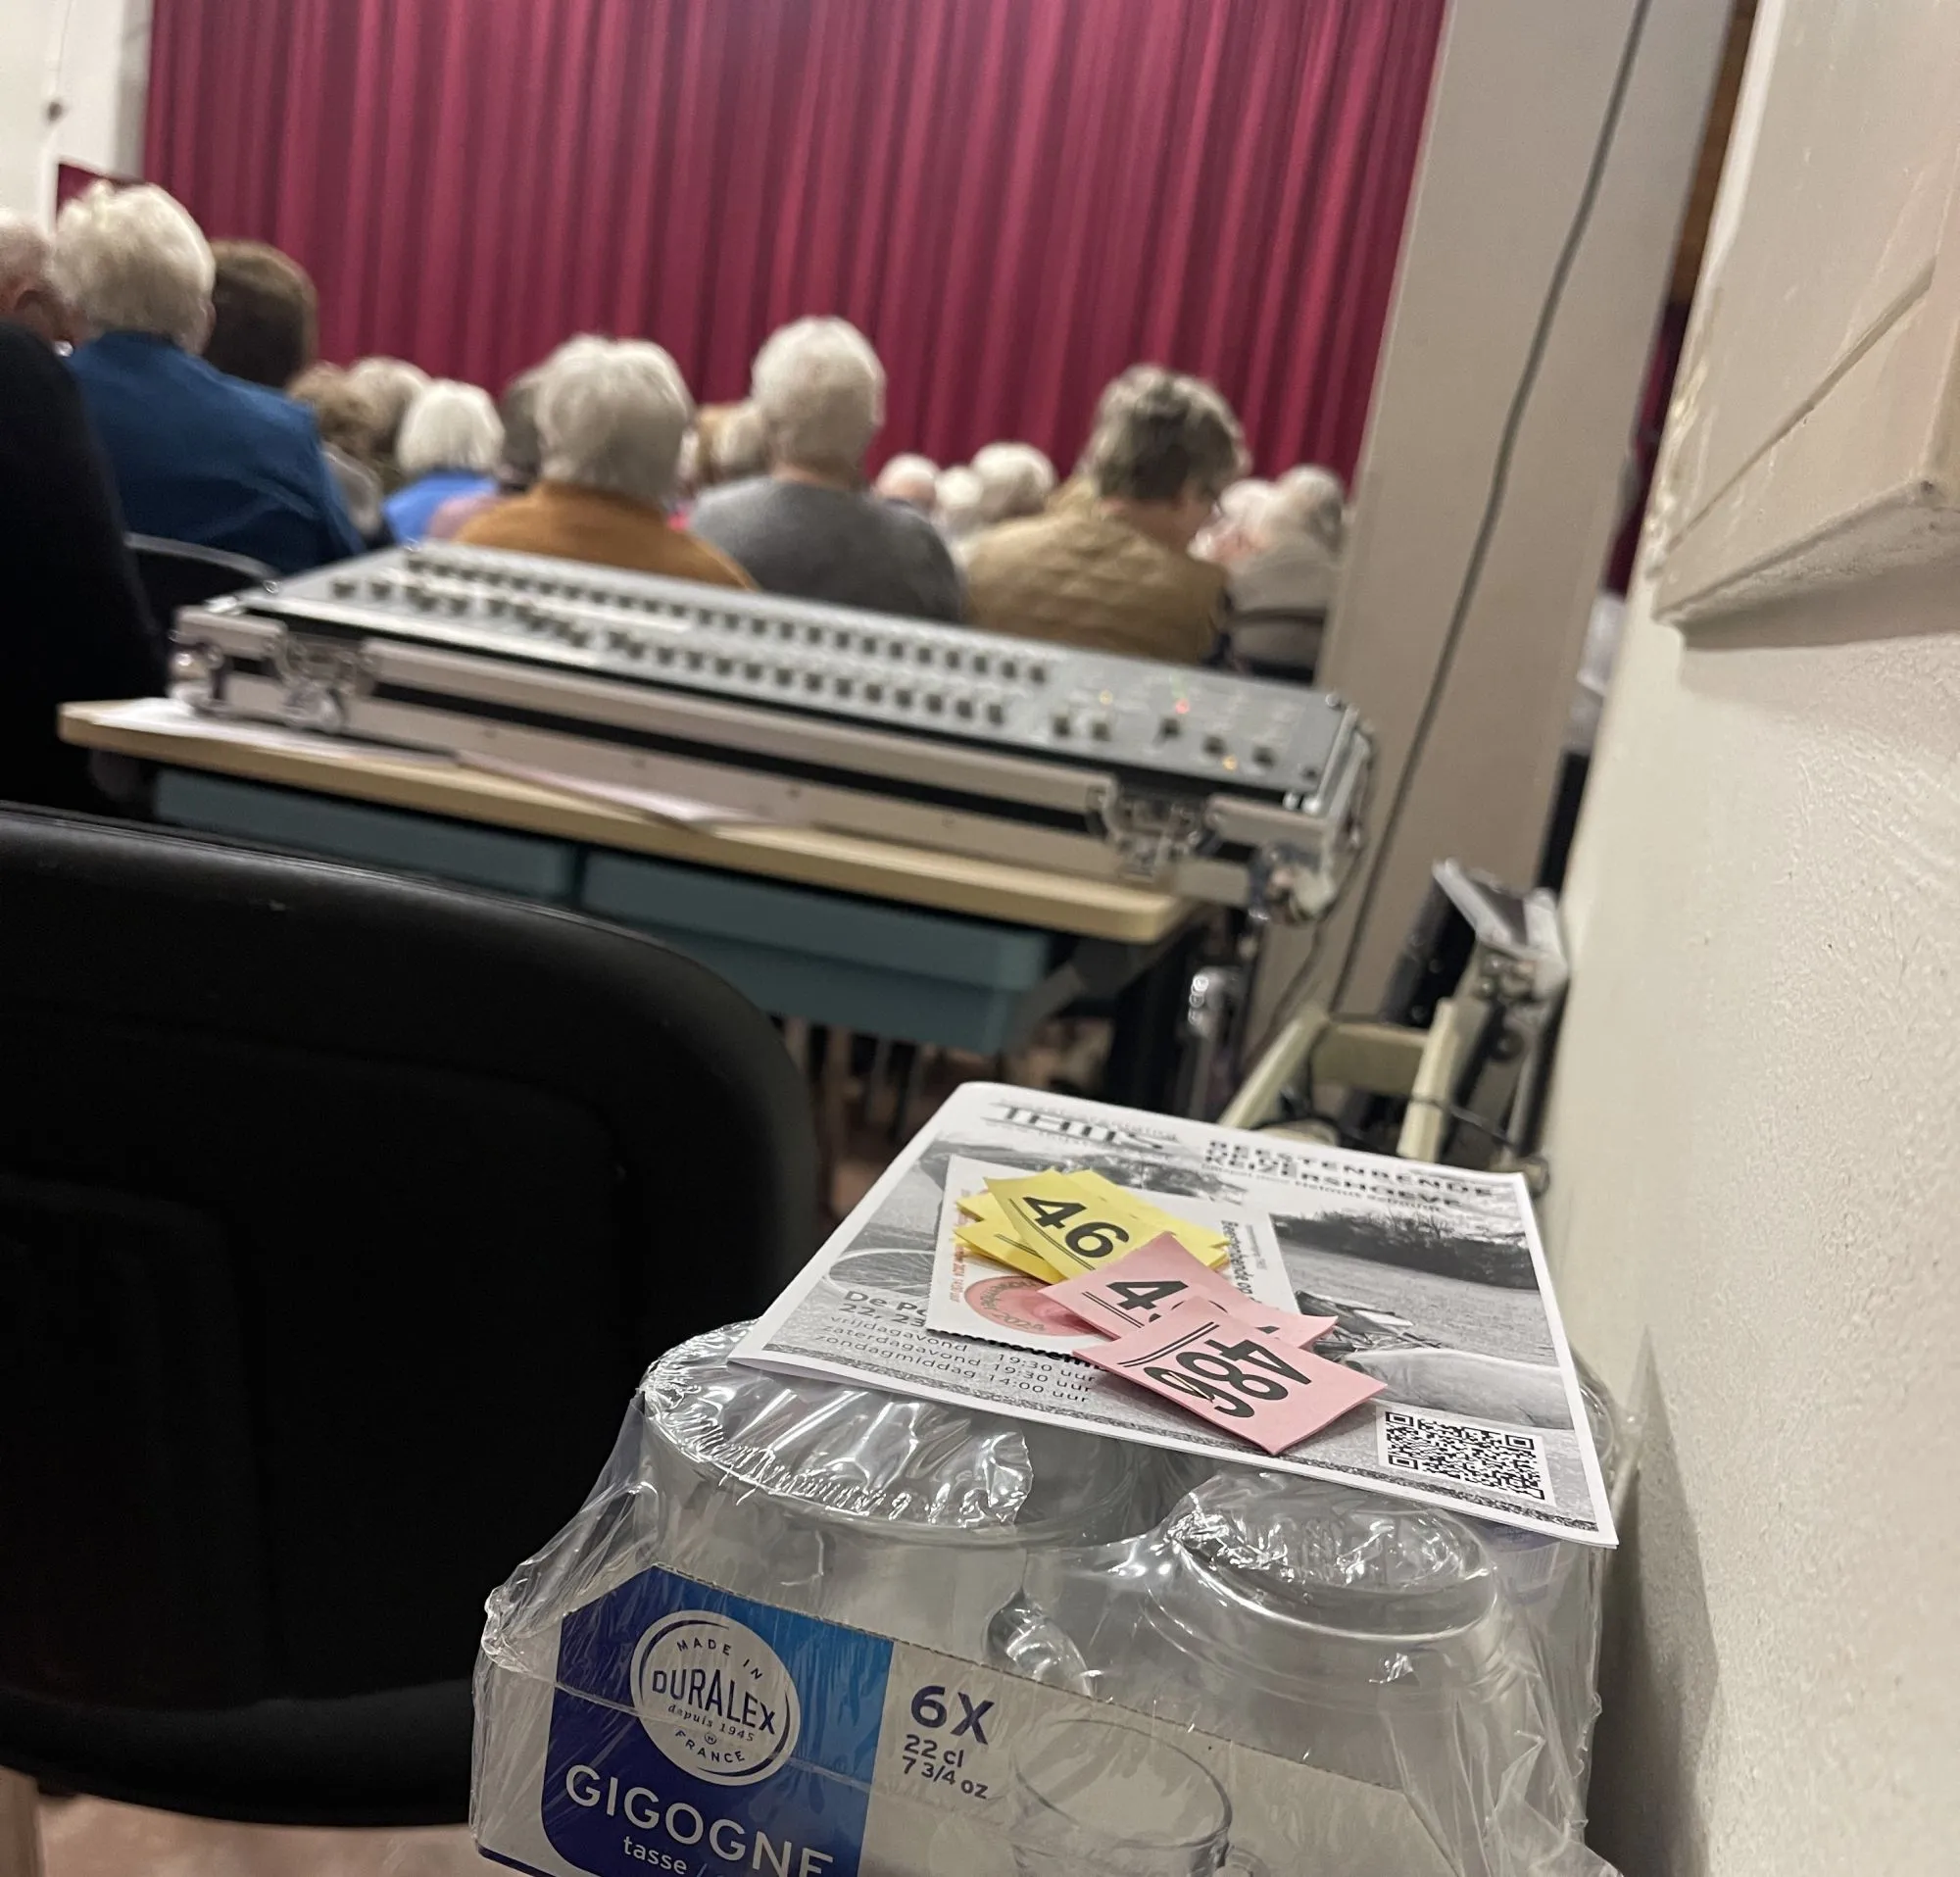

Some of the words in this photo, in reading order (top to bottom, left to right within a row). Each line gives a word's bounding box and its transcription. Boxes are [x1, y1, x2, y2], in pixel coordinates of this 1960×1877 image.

[1022, 1196, 1130, 1258] 46
[839, 1303, 883, 1319] 22,
[891, 1313, 928, 1328] 23
[845, 1290, 888, 1308] De
[814, 1335, 977, 1379] zondagmiddag
[988, 1374, 1045, 1394] 14:00
[1052, 1390, 1090, 1404] uur
[822, 1324, 981, 1367] zaterdagavond
[993, 1363, 1049, 1383] 19:30
[1056, 1379, 1093, 1394] uur
[831, 1315, 968, 1353] vrijdagavond
[998, 1354, 1054, 1374] 19:30
[1059, 1368, 1096, 1383] uur
[1143, 1339, 1312, 1418] 486
[676, 1637, 732, 1656] MADE
[743, 1658, 763, 1680] IN
[652, 1668, 776, 1735] DURALEX
[667, 1704, 713, 1728] depuis
[718, 1723, 756, 1743] 1945
[910, 1685, 995, 1746] 6X
[675, 1729, 746, 1763] FRANCE
[904, 1734, 938, 1760] 22
[943, 1750, 964, 1769] cl
[902, 1755, 917, 1775] 7
[920, 1761, 956, 1786] 3/4
[960, 1779, 989, 1801] oz
[565, 1764, 834, 1877] GIGOGNE
[623, 1835, 688, 1875] tasse
